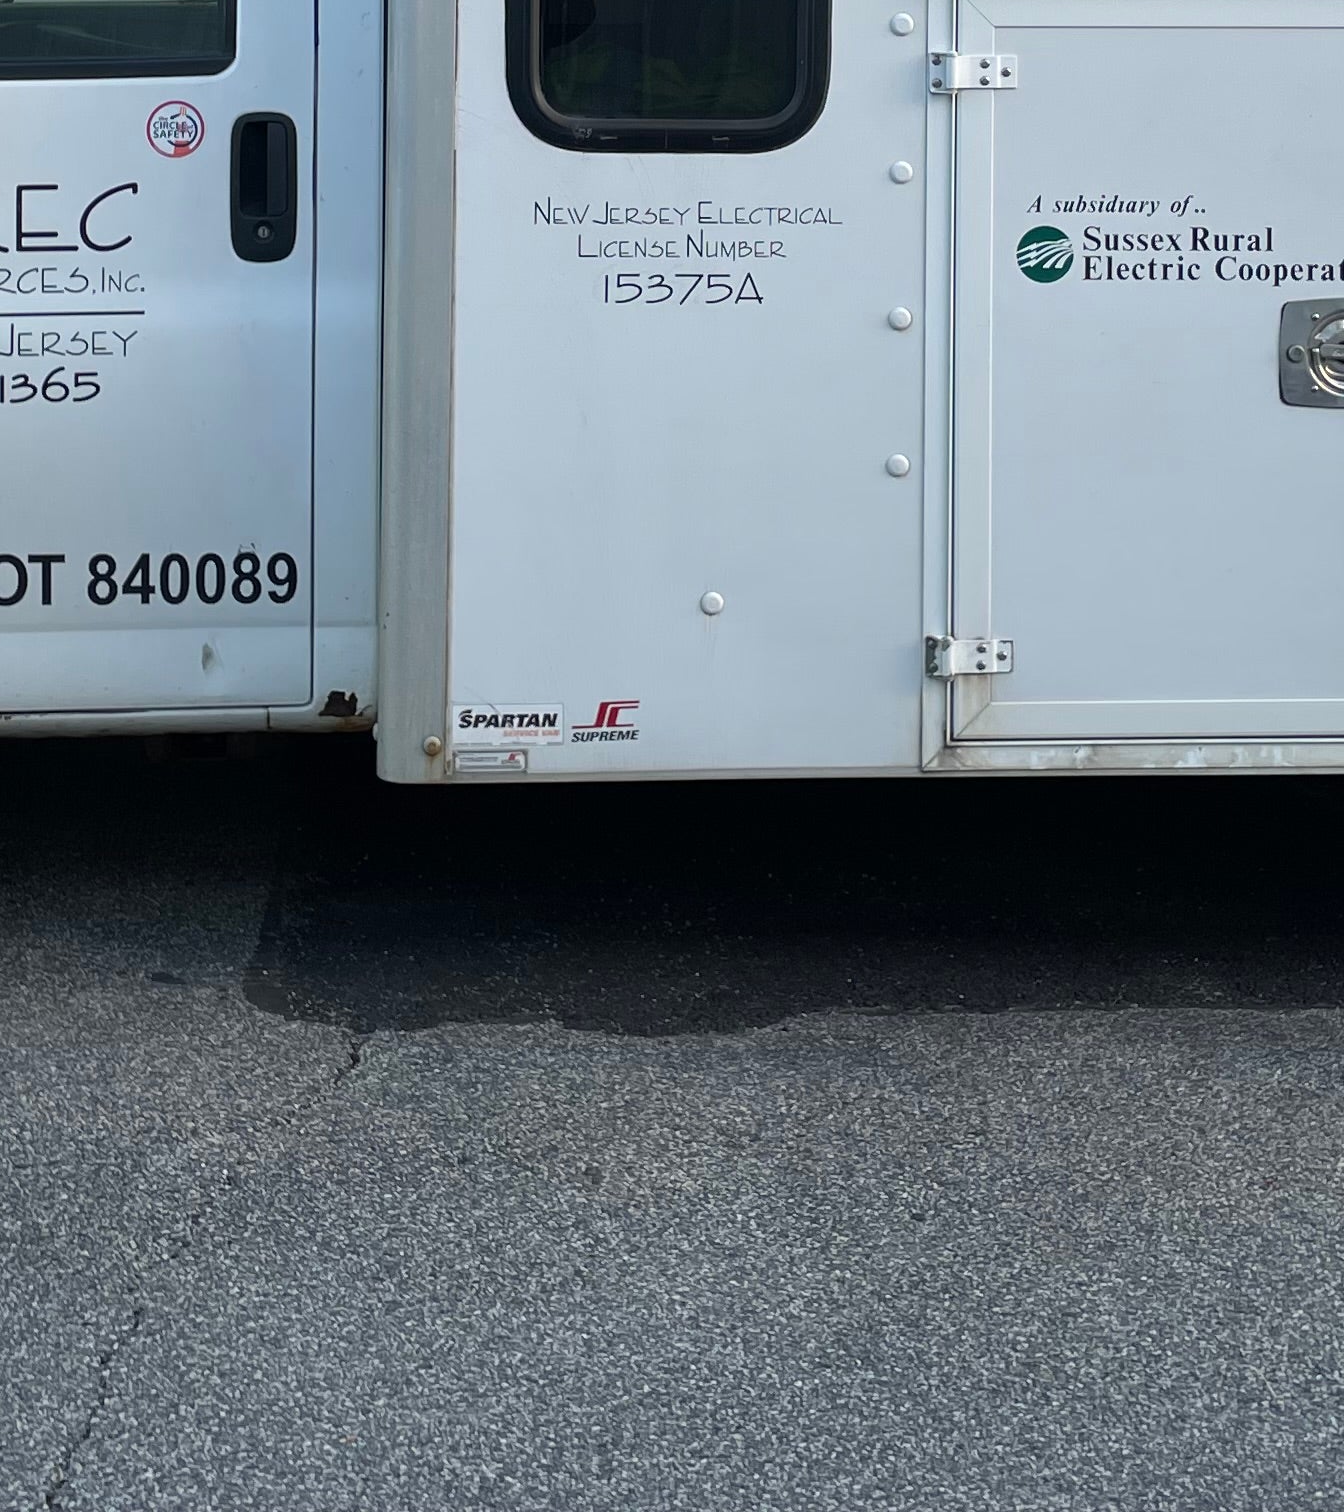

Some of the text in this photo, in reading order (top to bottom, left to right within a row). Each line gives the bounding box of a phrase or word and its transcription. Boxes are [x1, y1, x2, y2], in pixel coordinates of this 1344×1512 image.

[153, 129, 194, 139] SAFETY
[1027, 195, 1043, 213] A
[1053, 194, 1160, 217] subsidiary
[1082, 225, 1274, 253] Sussex Rural
[1081, 255, 1202, 281] Electric
[603, 271, 765, 306] 15375A
[86, 551, 299, 606] 840089
[458, 709, 559, 729] SPARTAN
[571, 730, 641, 743] SUPREME
